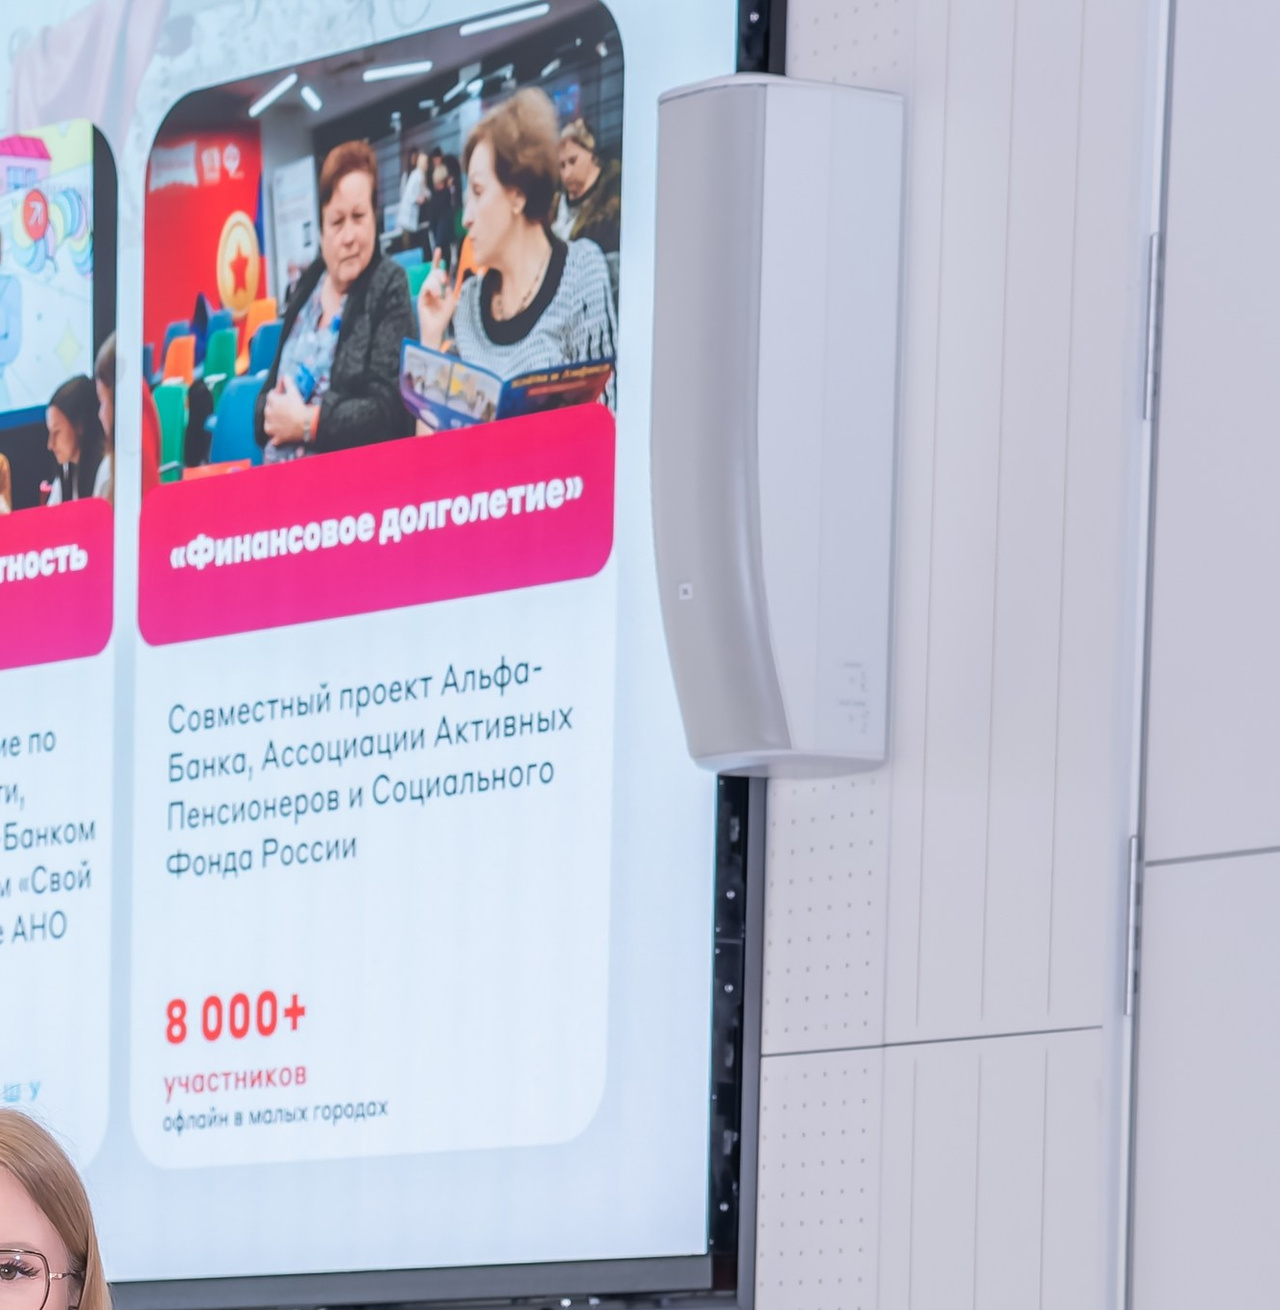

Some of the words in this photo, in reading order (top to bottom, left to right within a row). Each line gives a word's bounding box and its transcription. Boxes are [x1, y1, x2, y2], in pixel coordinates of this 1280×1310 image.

[170, 514, 376, 570] «Финансовое
[379, 475, 584, 545] долголетие»
[168, 683, 331, 734] Совместный
[339, 676, 433, 718] проект
[440, 655, 542, 698] Альфа-
[28, 730, 56, 754] по
[168, 752, 254, 783] Банка,
[261, 730, 425, 774] Ассоциации
[433, 706, 573, 746] Активных
[167, 788, 340, 831] Пенсионеров
[348, 785, 363, 806] и
[372, 761, 555, 807] Социального
[18, 860, 92, 895] «Свой
[167, 849, 252, 879] Фонда
[262, 835, 357, 869] России
[11, 910, 67, 944] АНО
[163, 1065, 307, 1103] участников
[163, 1106, 228, 1136] офлайн
[234, 1111, 242, 1126] в
[249, 1104, 307, 1126] малых
[313, 1100, 387, 1125] городах
